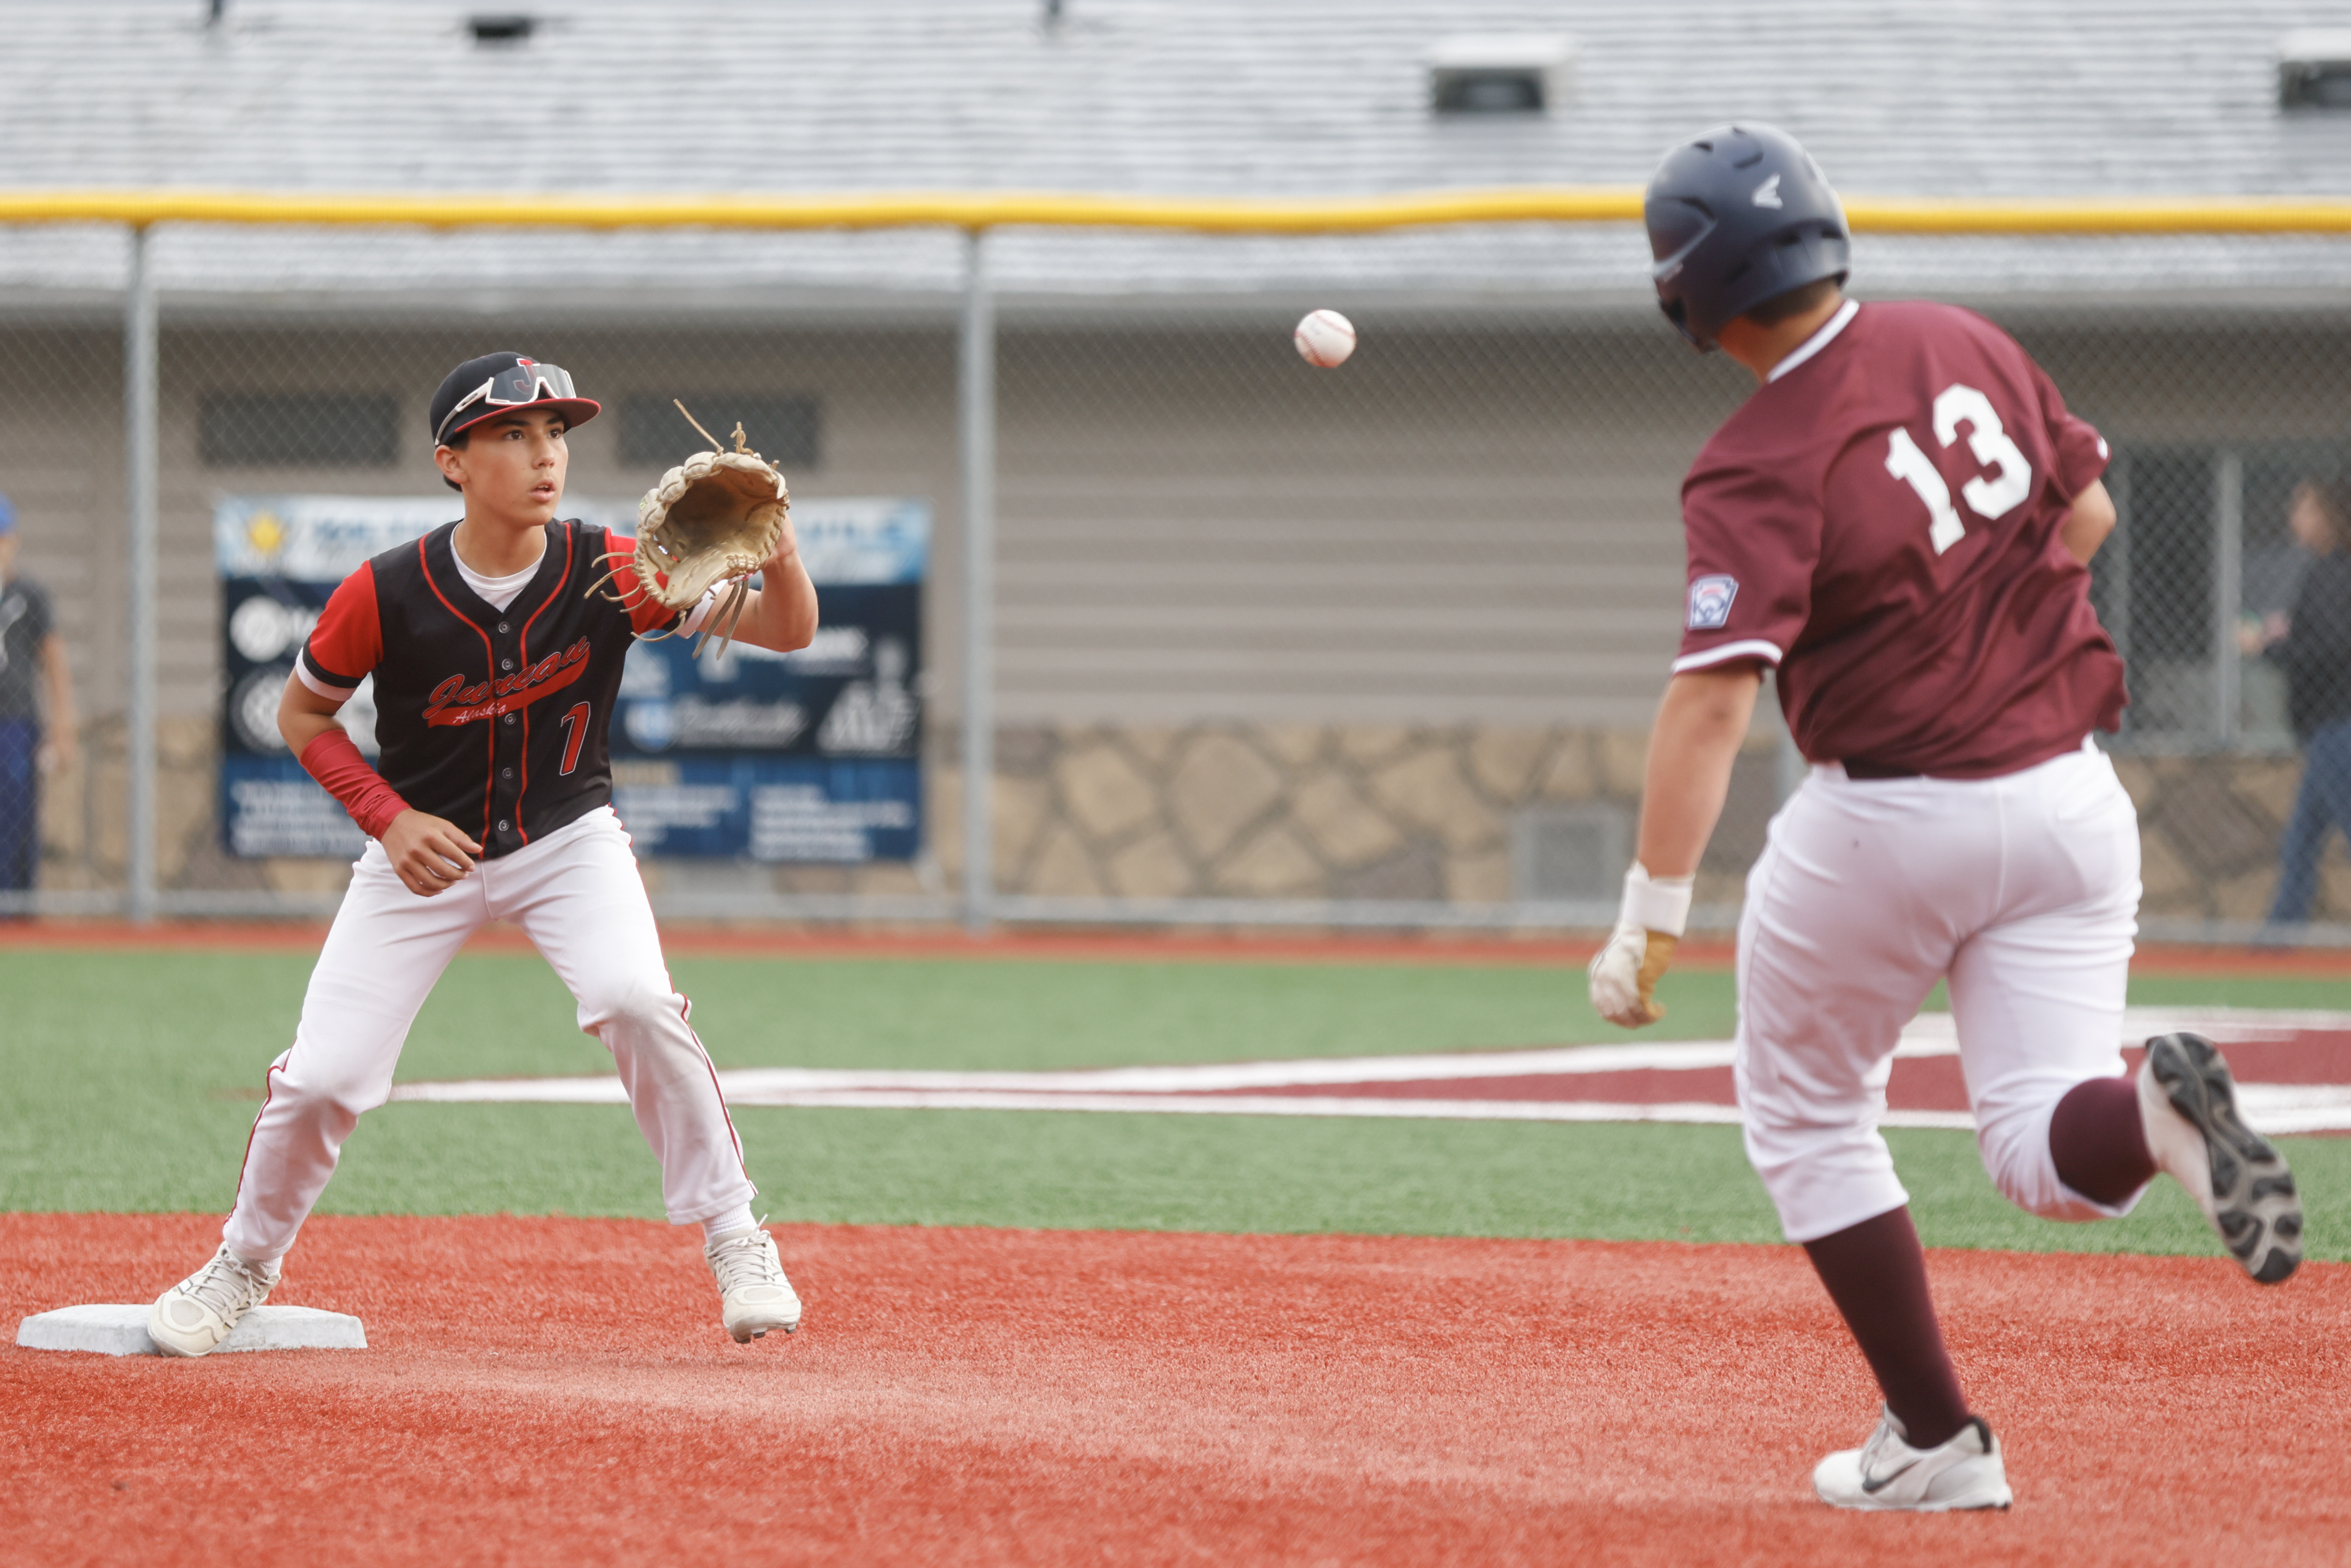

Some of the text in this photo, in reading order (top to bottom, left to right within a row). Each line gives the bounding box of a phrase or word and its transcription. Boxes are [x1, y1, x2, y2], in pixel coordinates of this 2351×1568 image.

[1884, 382, 2032, 556] 13
[422, 636, 590, 719] Juneau
[452, 702, 507, 724] Alaska
